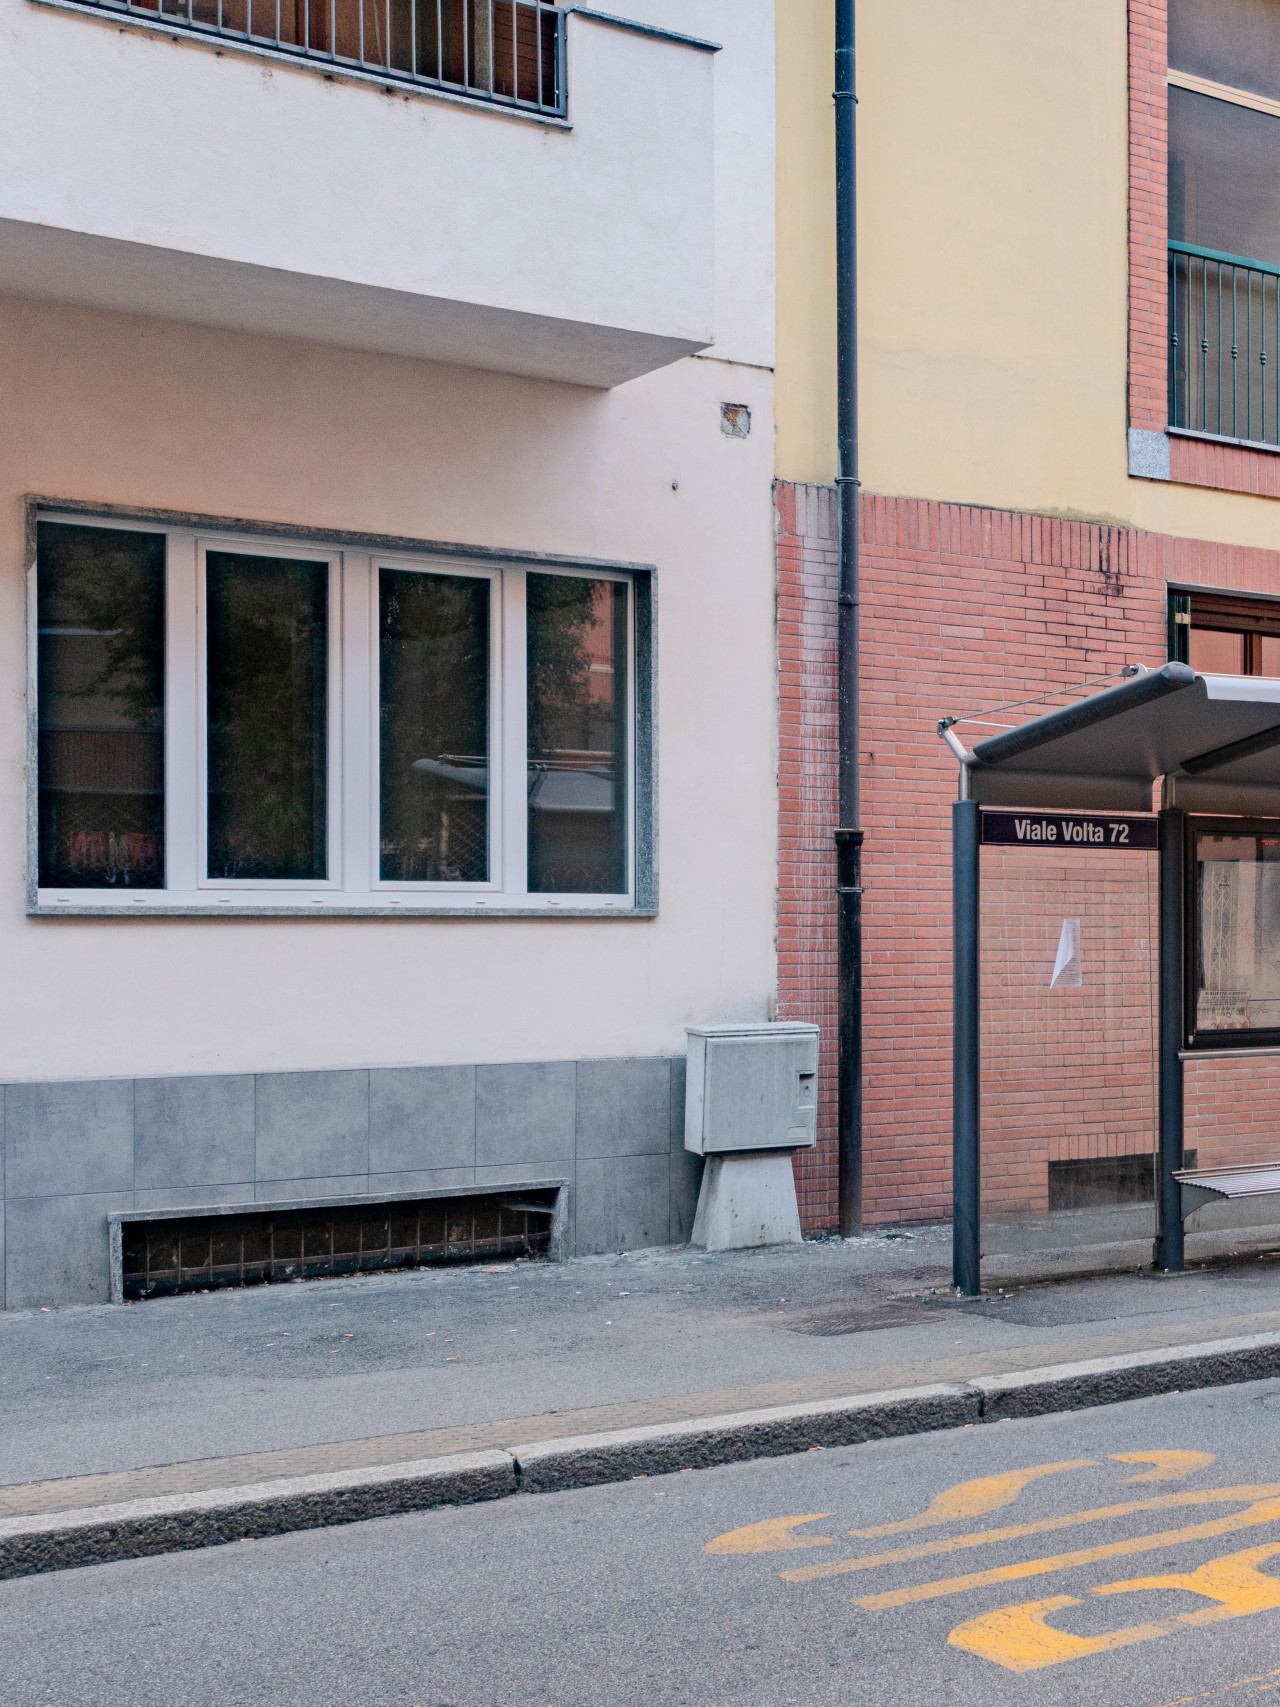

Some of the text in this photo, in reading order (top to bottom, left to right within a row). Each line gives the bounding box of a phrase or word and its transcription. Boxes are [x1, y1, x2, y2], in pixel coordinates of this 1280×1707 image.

[1014, 819, 1130, 843] Viale Volta 72
